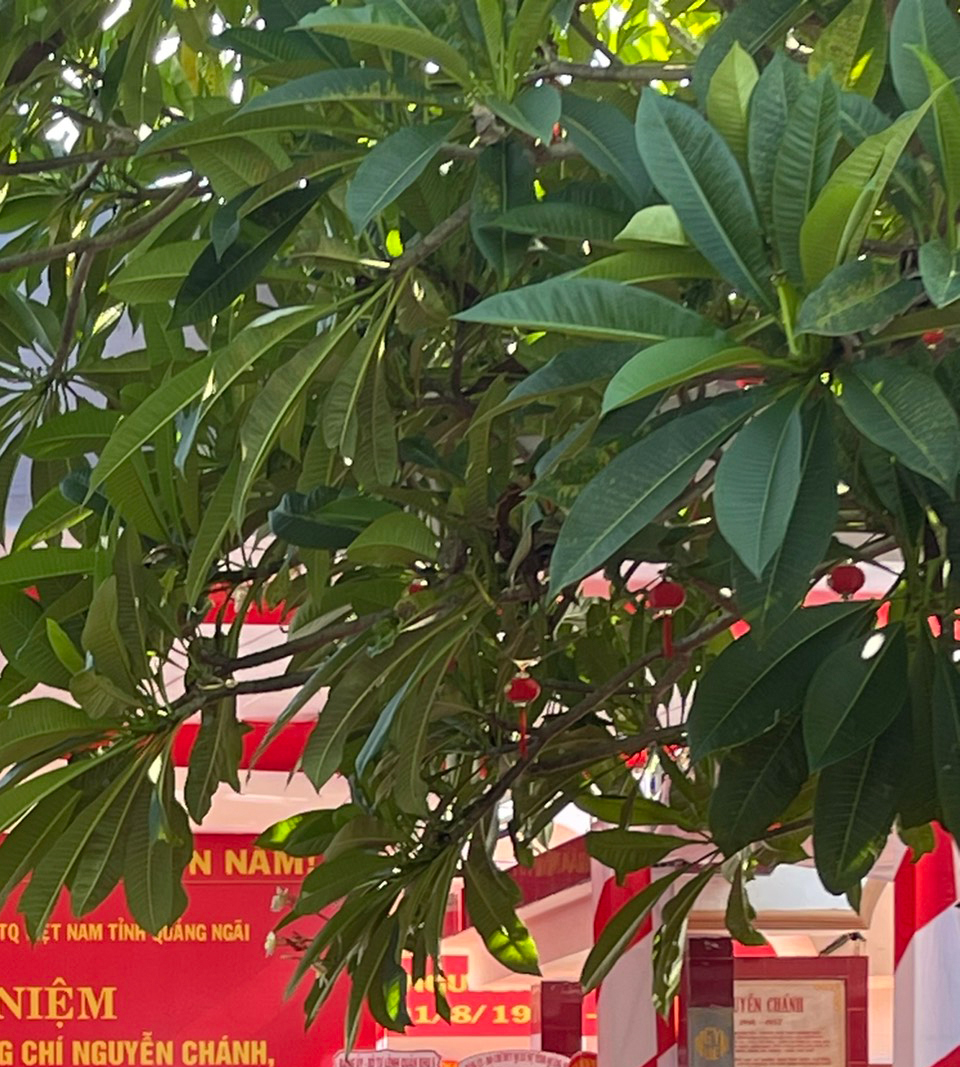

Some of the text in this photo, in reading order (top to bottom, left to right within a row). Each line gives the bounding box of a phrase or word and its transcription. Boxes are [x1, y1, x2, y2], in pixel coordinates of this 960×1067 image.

[66, 923, 103, 941] NAM
[107, 916, 147, 942] TỈNH
[211, 918, 251, 942] NGÃI
[21, 1035, 64, 1066] CHÍ
[72, 1031, 174, 1066] NGUYỄN
